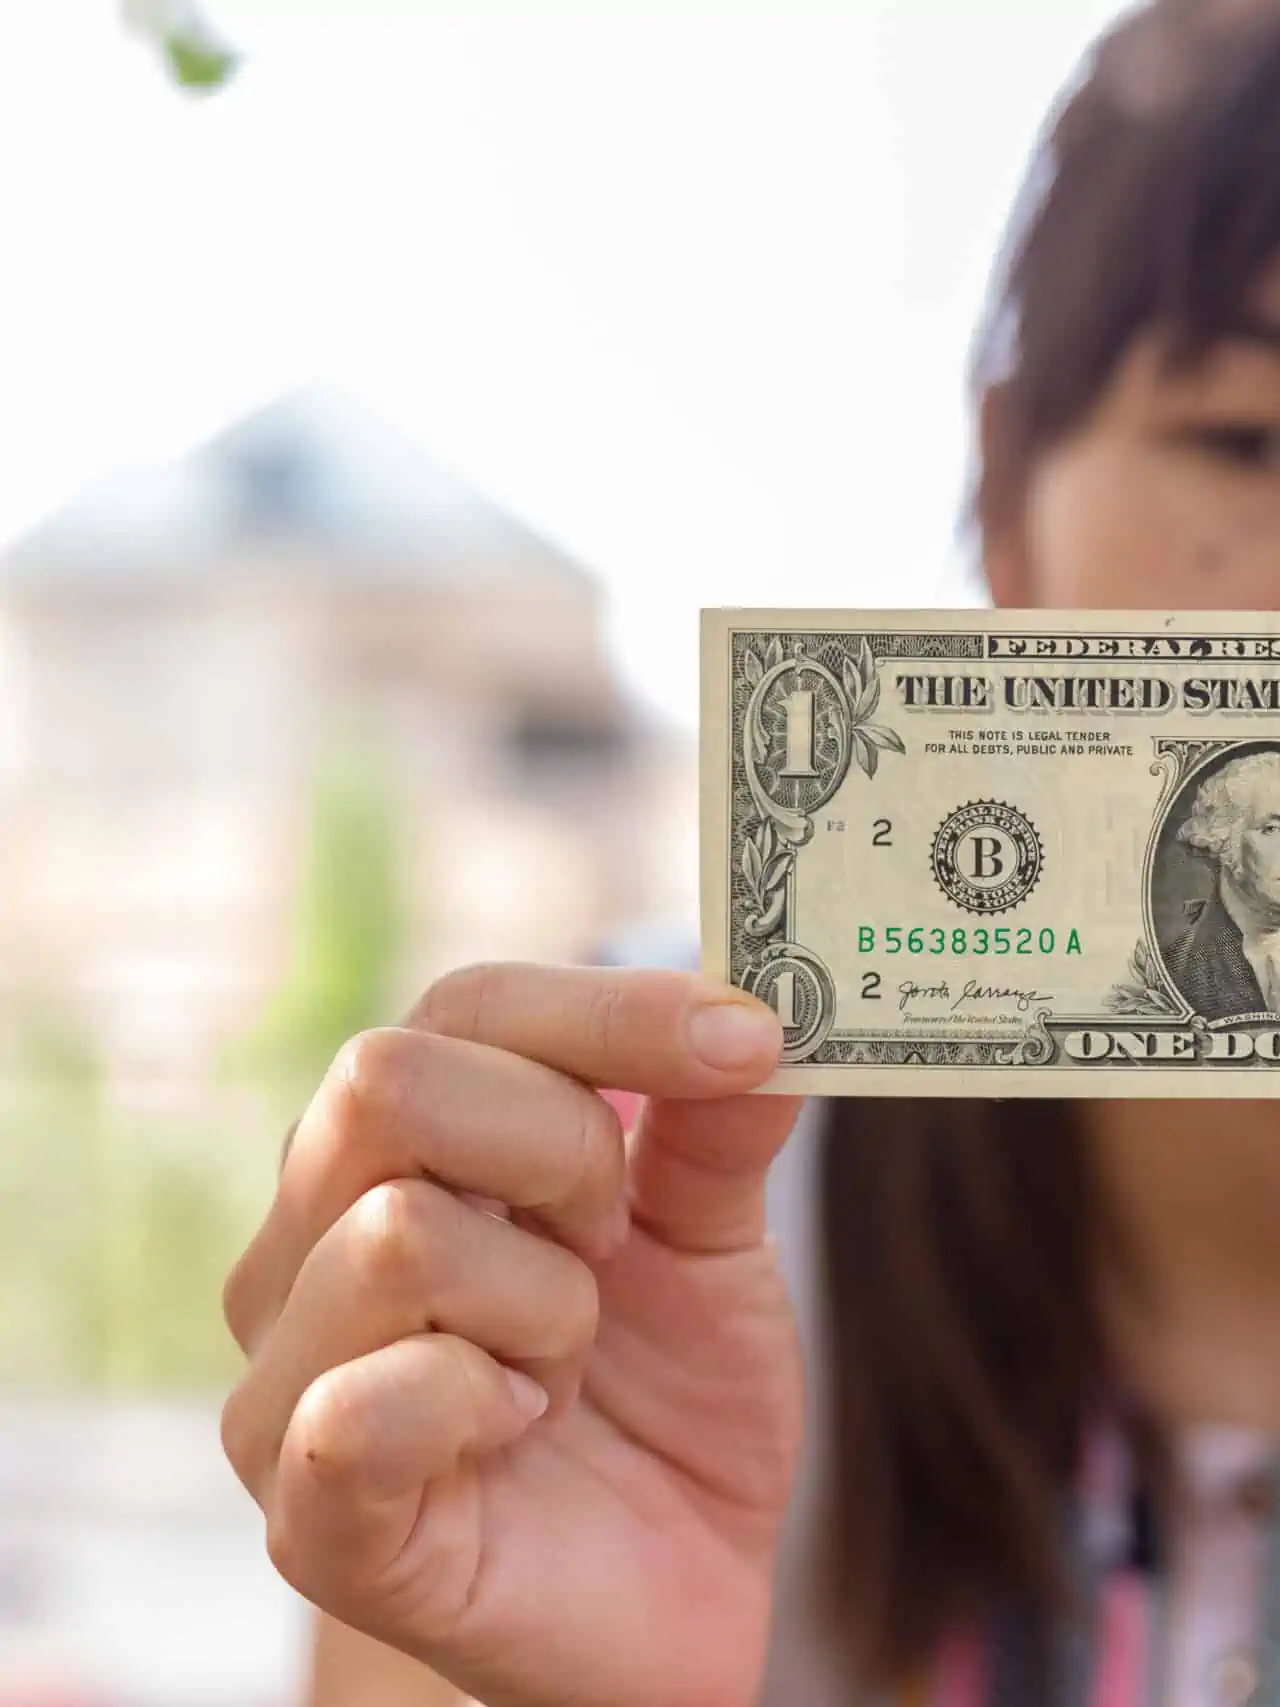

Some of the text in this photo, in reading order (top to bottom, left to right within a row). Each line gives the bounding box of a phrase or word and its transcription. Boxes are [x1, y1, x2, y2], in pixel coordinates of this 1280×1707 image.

[994, 639, 1207, 657] FEDERAL
[897, 676, 993, 713] THE
[1003, 676, 1180, 715] UNITED
[775, 691, 820, 779] 1
[948, 730, 1112, 742] THIS NOTE IS LEGAL TENDER
[925, 743, 1134, 757] FOR ALL DEBTS, PUBLIC AND PRIVATE
[873, 819, 893, 846] 2
[969, 836, 1004, 878] B
[771, 971, 801, 1029] 1
[861, 972, 882, 999] 2
[1063, 1030, 1196, 1061] ONE
